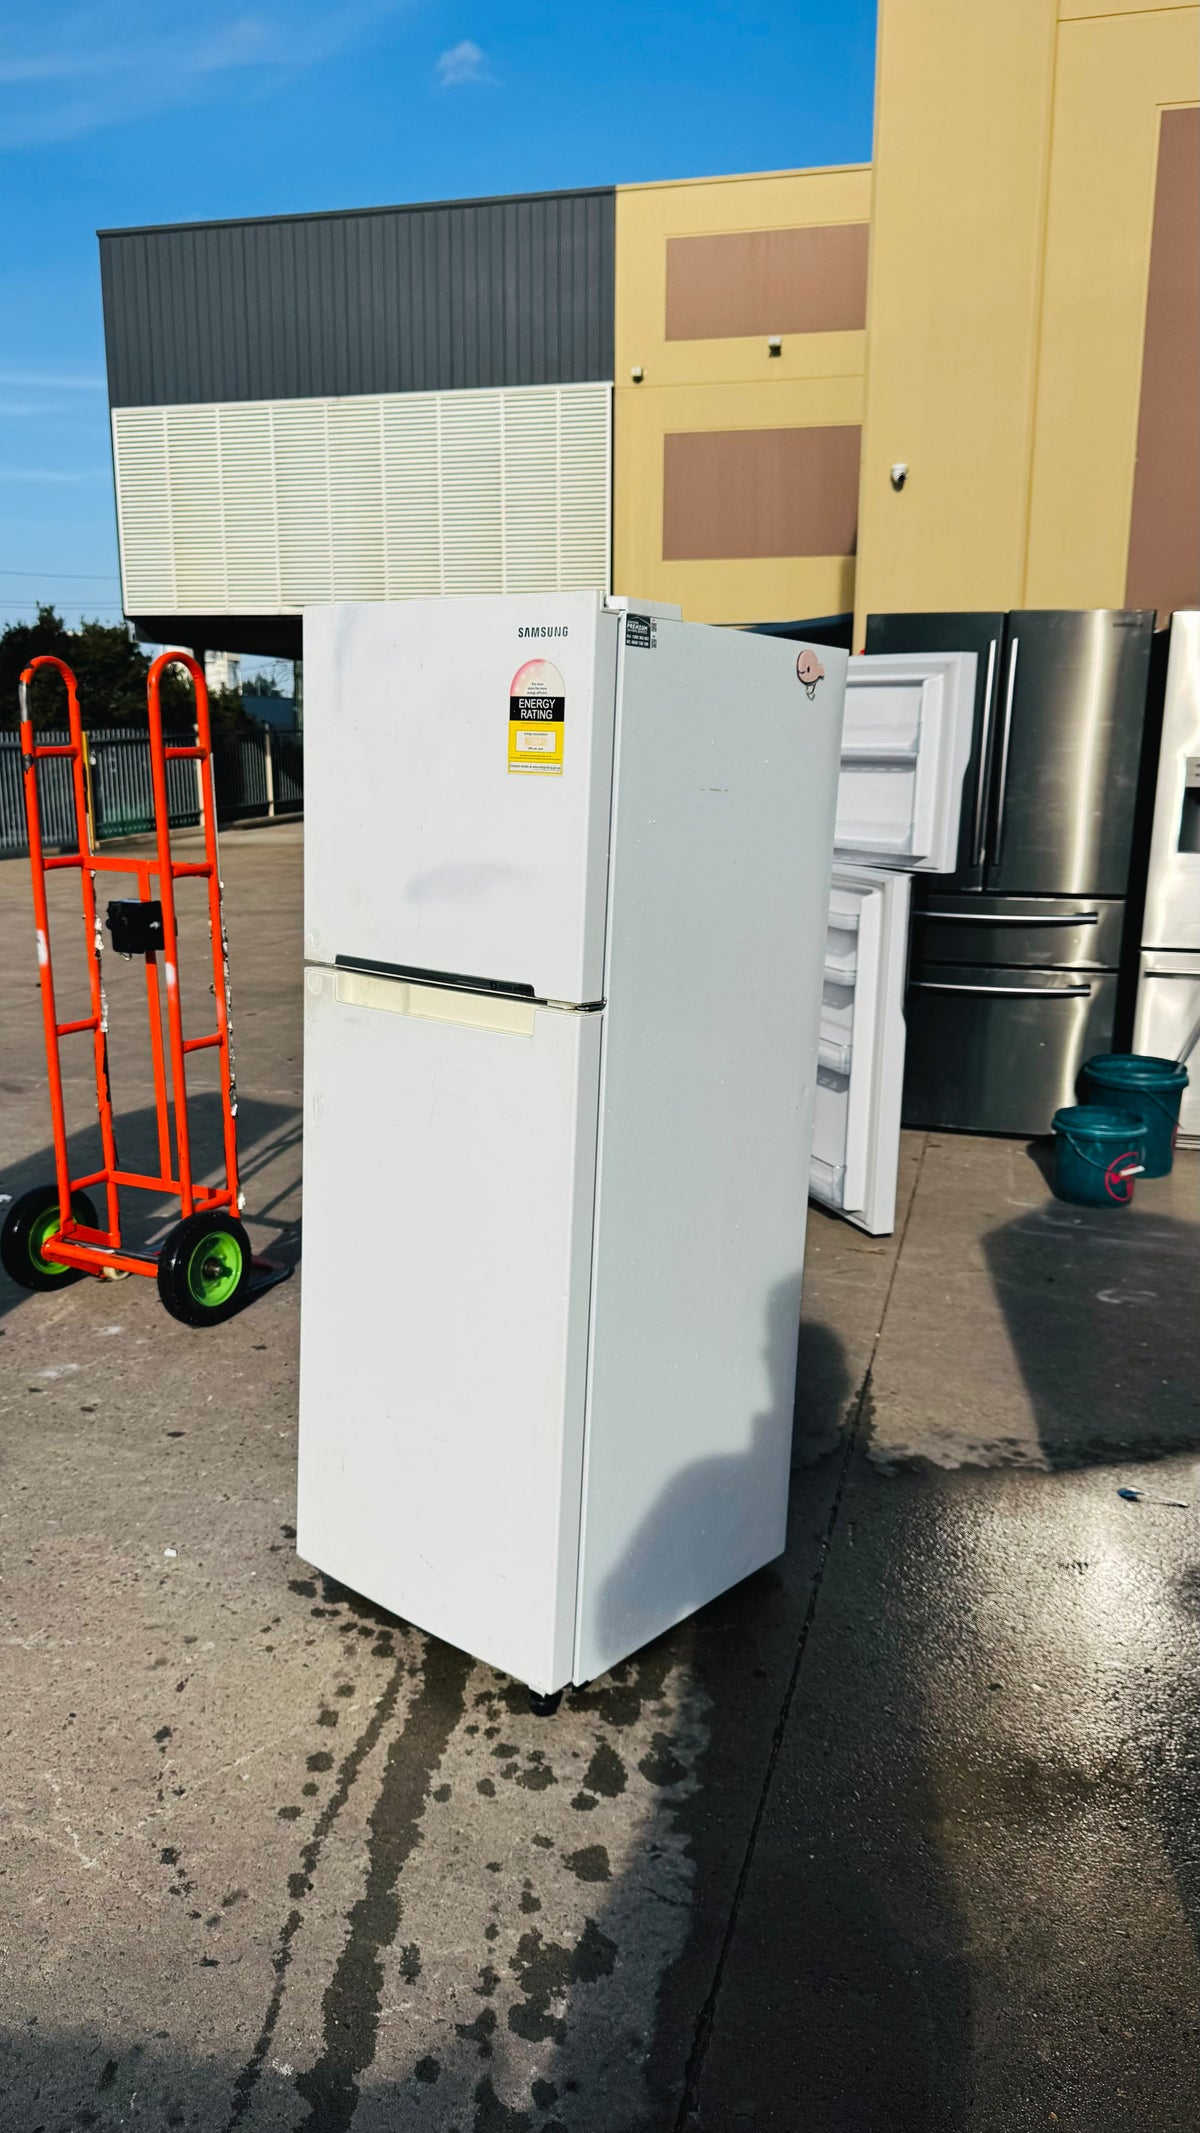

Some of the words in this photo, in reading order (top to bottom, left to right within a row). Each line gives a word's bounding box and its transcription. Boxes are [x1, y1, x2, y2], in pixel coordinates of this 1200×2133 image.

[518, 626, 568, 638] SAMSUNG
[518, 698, 556, 709] ENERGY
[520, 709, 553, 720] RATING
